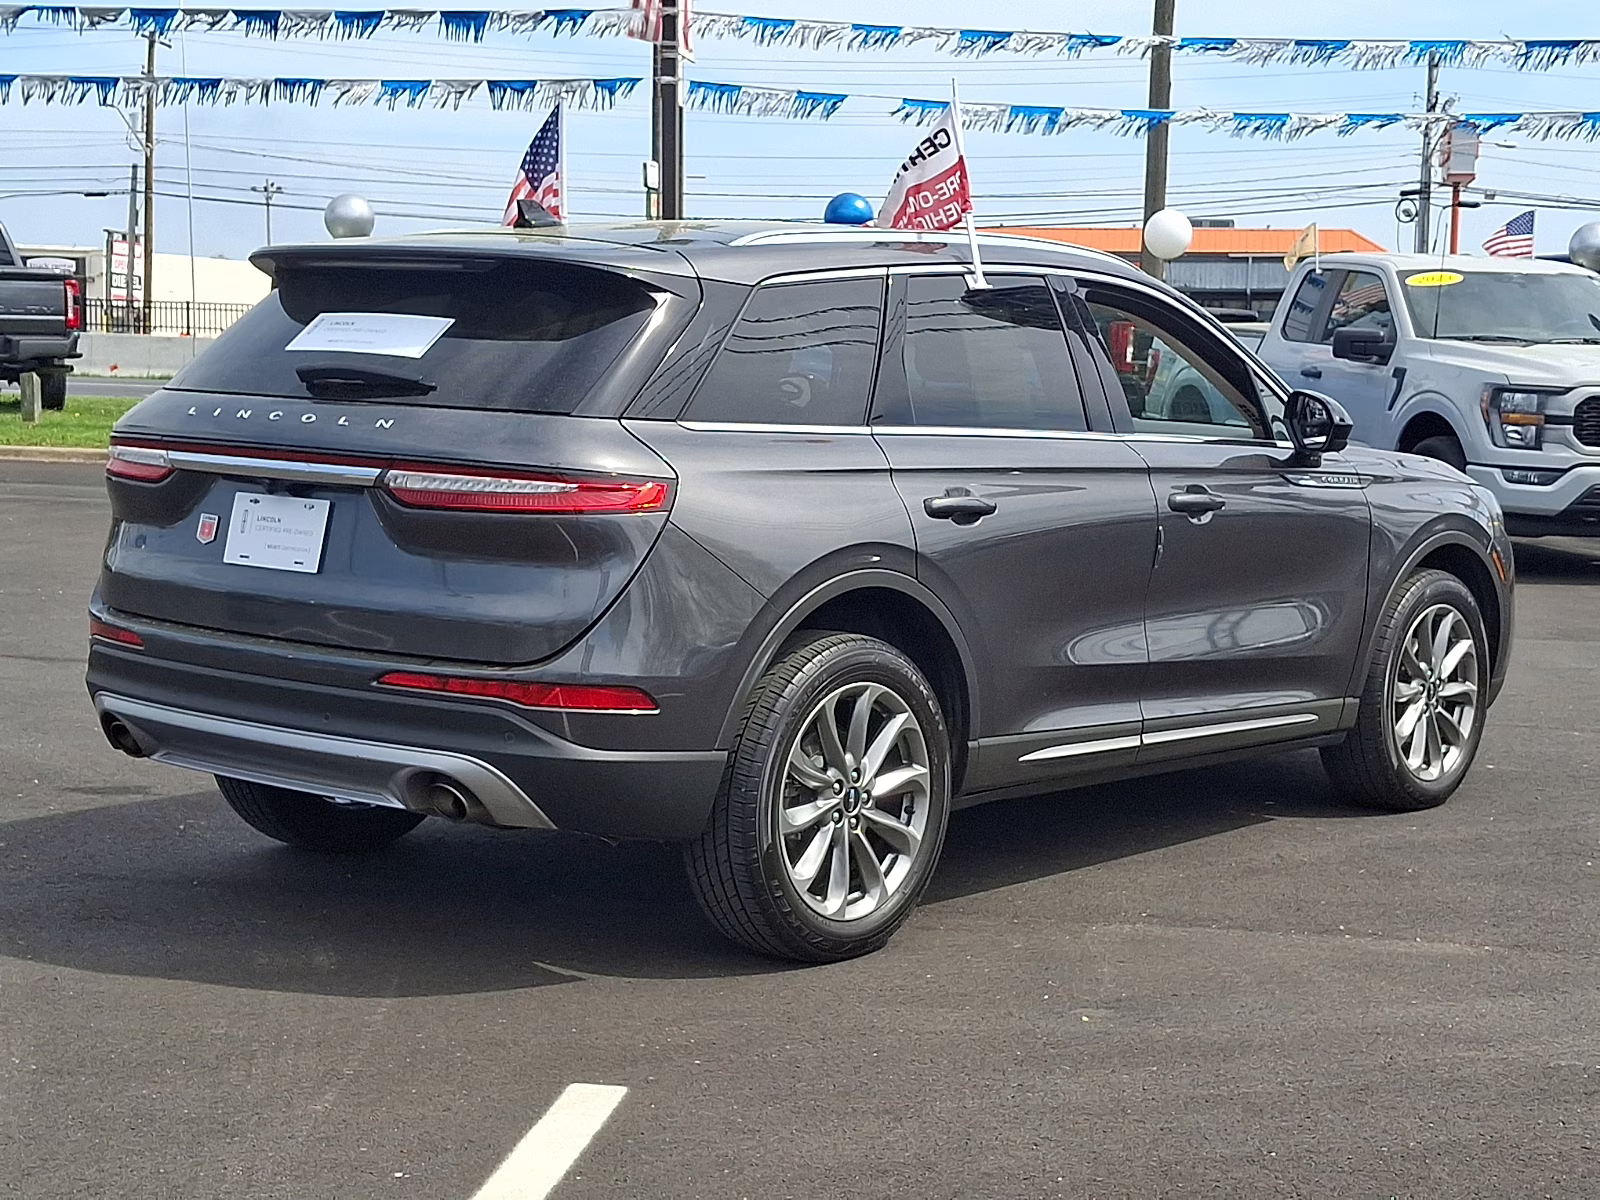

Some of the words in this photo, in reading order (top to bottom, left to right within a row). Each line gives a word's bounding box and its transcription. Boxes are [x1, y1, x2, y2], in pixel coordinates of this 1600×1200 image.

[112, 274, 142, 290] DIEEL
[188, 406, 394, 429] LINCOLN
[257, 515, 281, 523] LINCOLN
